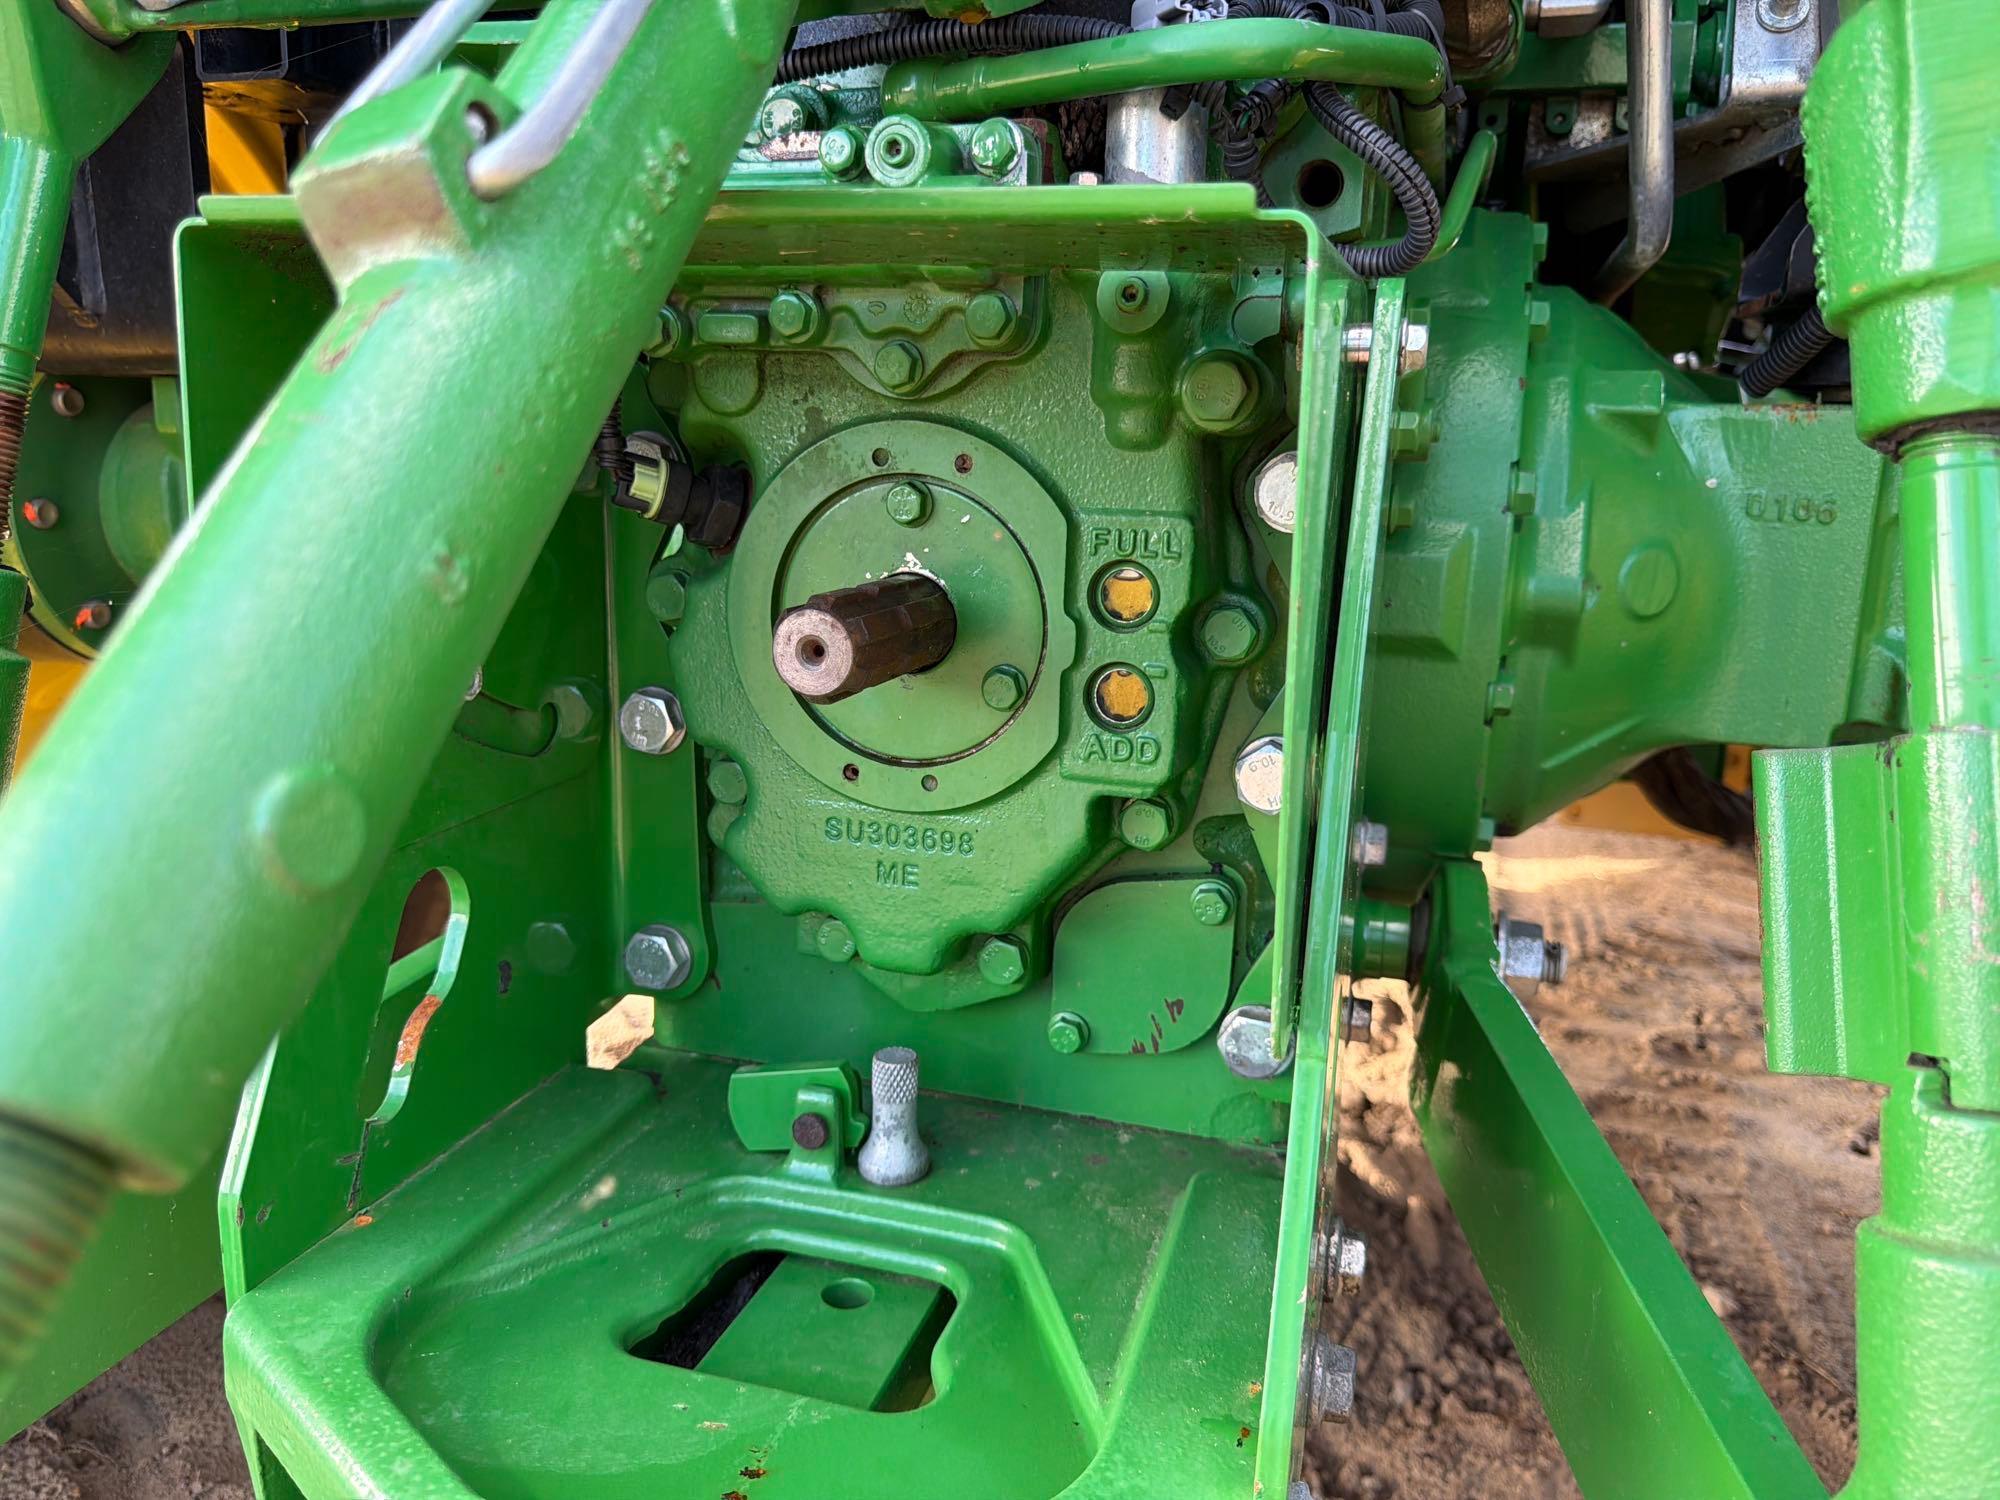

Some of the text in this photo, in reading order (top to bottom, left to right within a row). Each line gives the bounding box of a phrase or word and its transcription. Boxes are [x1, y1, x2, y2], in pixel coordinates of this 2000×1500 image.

[1088, 526, 1182, 560] FULL
[1080, 732, 1162, 765] ADD
[1248, 754, 1277, 773] 10.9
[823, 815, 976, 858] SU303698
[876, 859, 920, 889] ME
